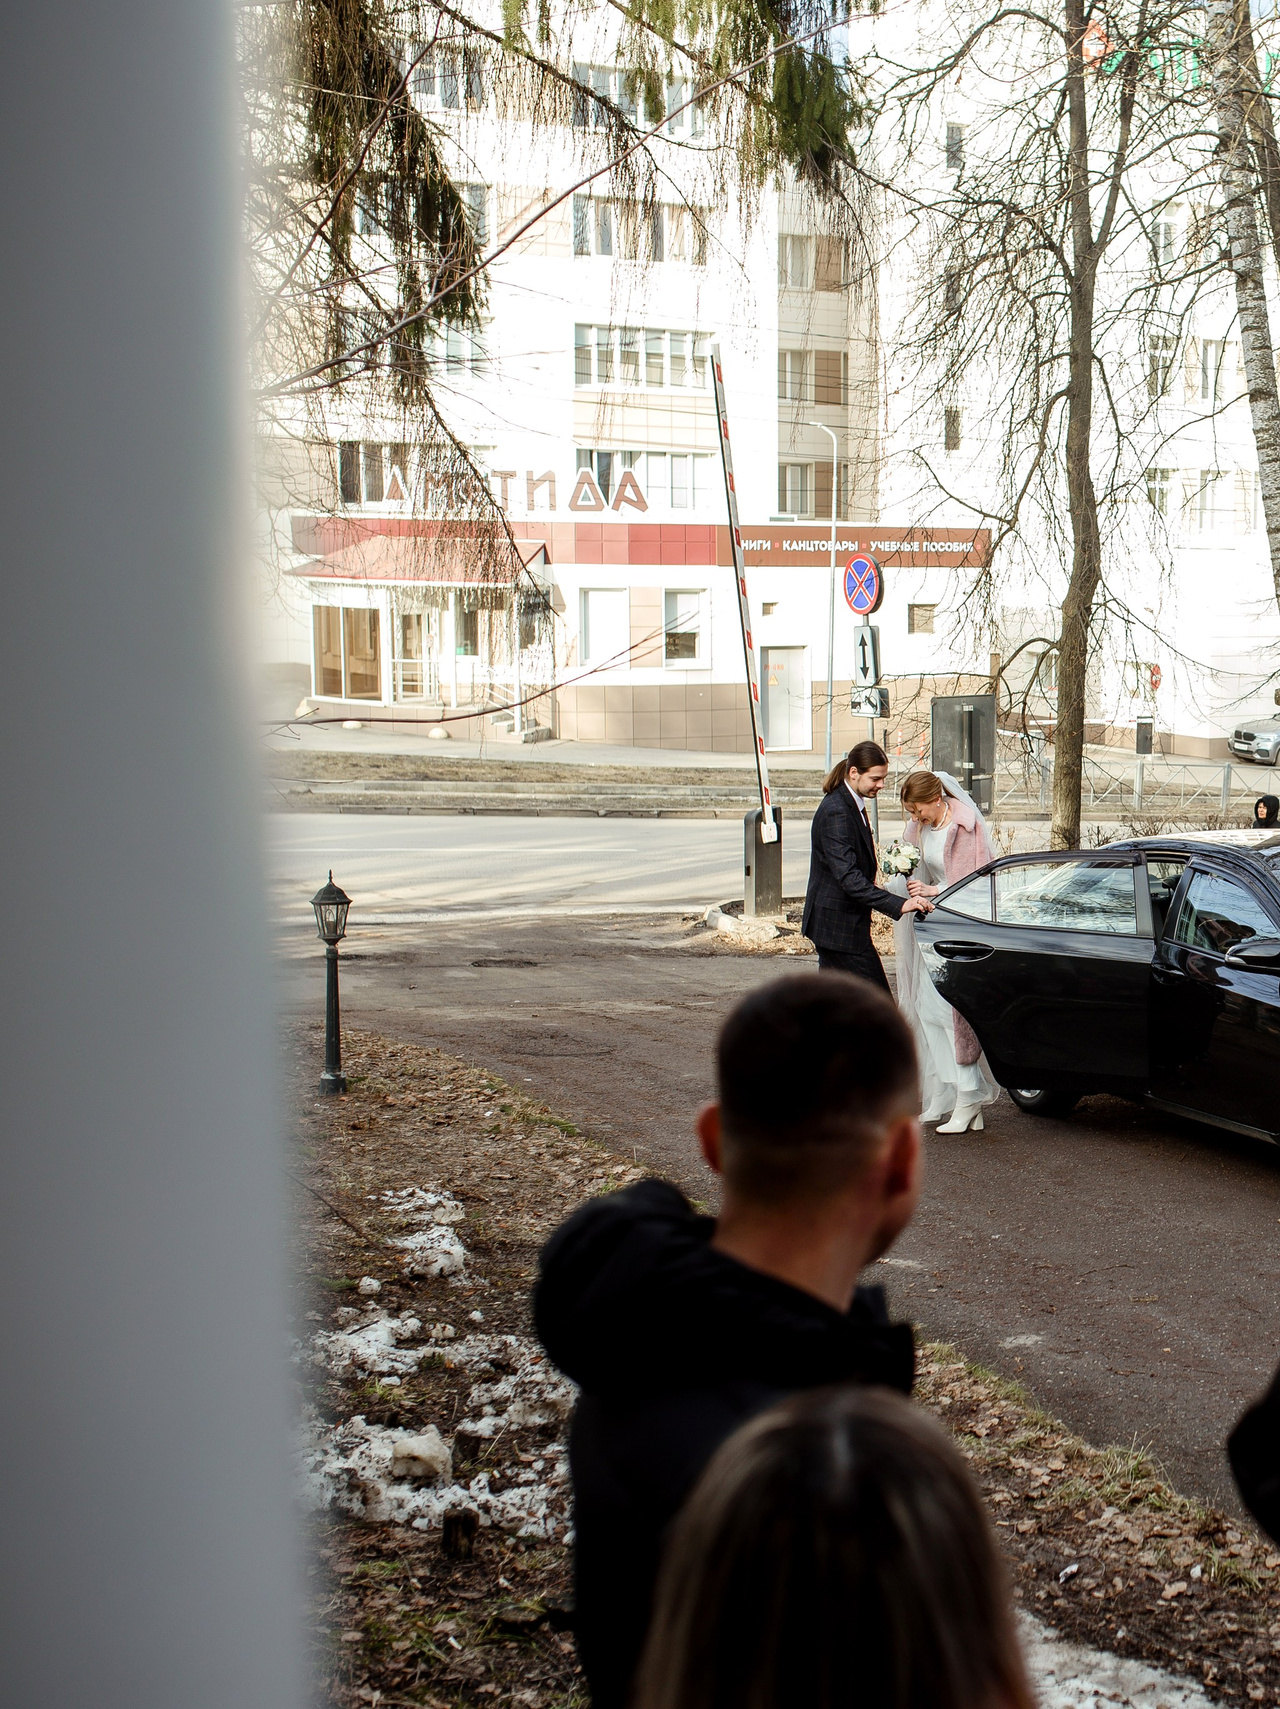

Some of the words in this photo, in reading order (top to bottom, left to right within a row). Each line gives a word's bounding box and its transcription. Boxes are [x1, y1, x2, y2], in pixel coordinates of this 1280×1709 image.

[740, 539, 772, 551] НИГИ
[870, 540, 920, 552] УЧЕБНЫЕ
[922, 541, 974, 553] ПОСОБИЯ
